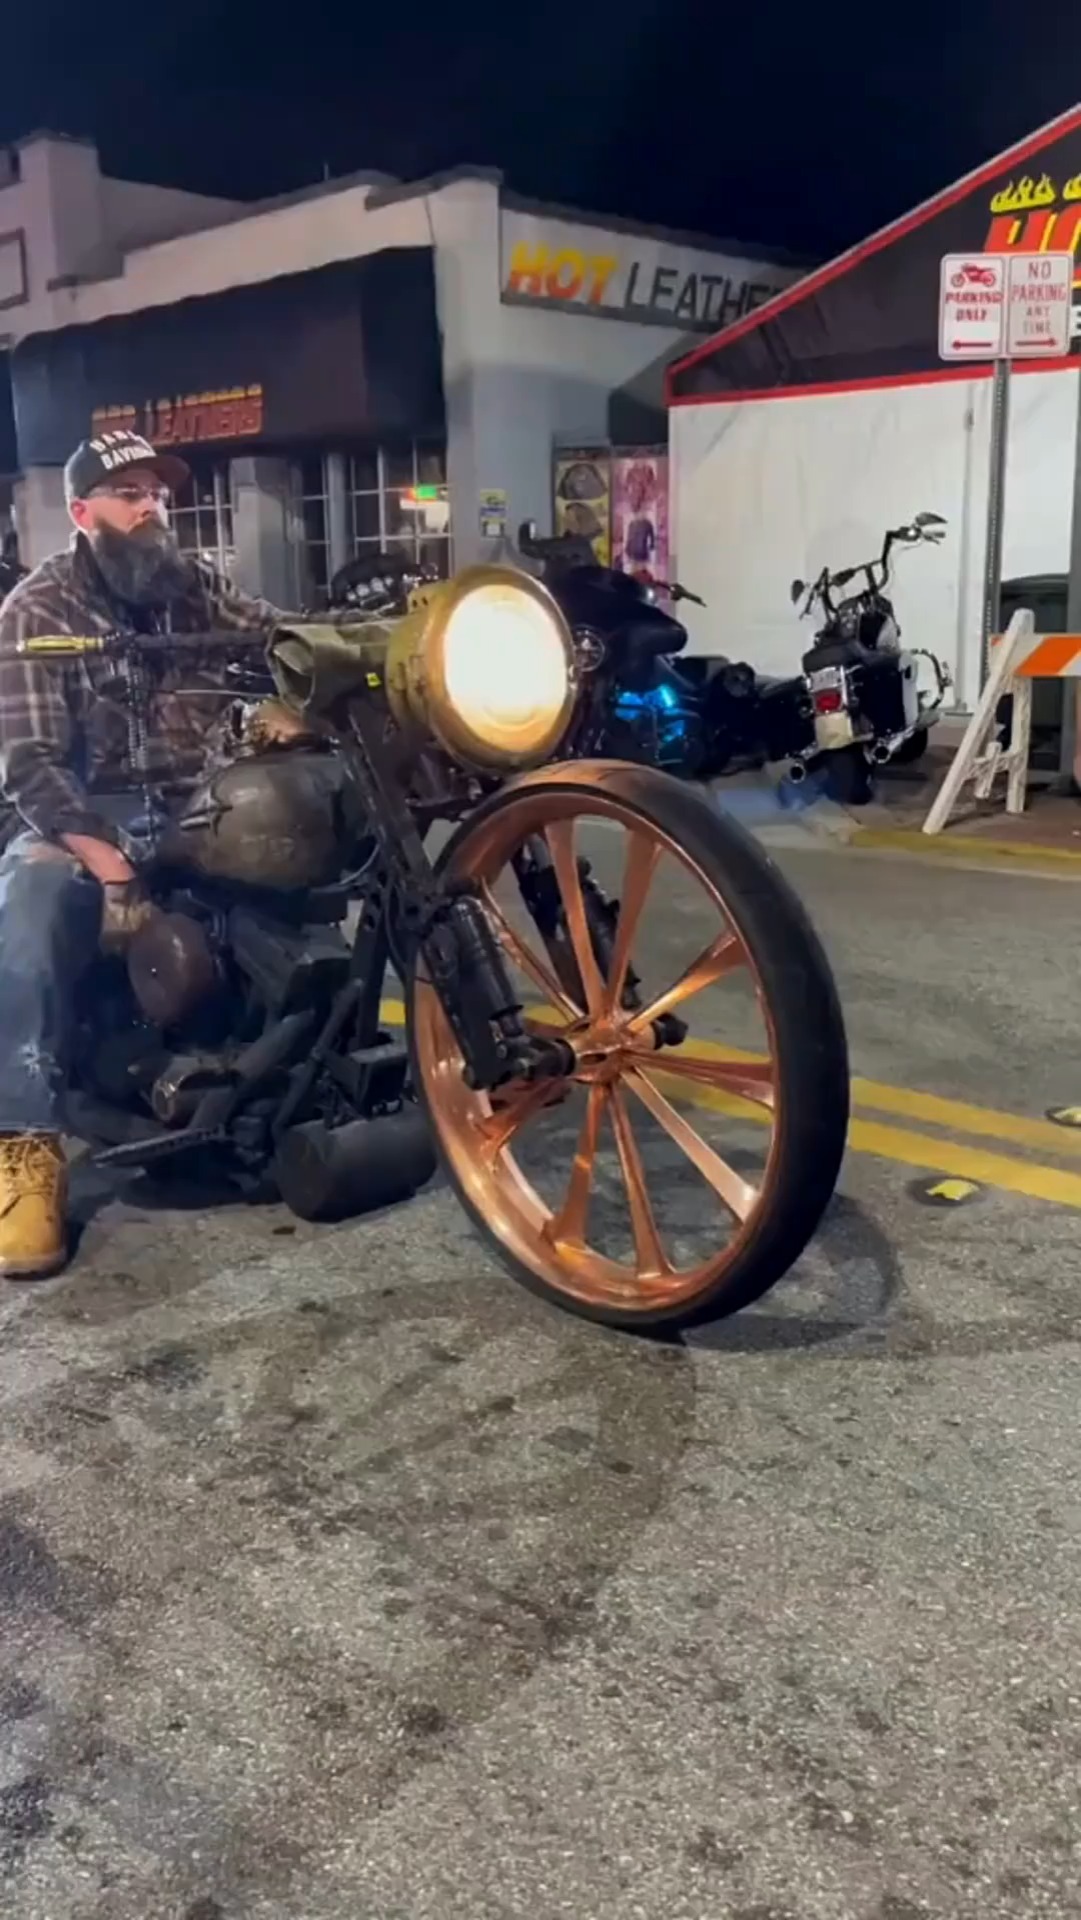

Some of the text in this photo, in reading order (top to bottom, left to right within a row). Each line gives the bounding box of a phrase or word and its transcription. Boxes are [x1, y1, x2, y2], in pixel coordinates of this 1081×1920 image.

[1028, 261, 1052, 280] NO
[508, 241, 783, 321] HOT LEATHE
[945, 291, 1004, 305] PARKING
[1011, 284, 1067, 302] PARKING
[956, 308, 988, 322] ONLY
[1026, 306, 1050, 317] ANY
[1022, 321, 1052, 336] TIME
